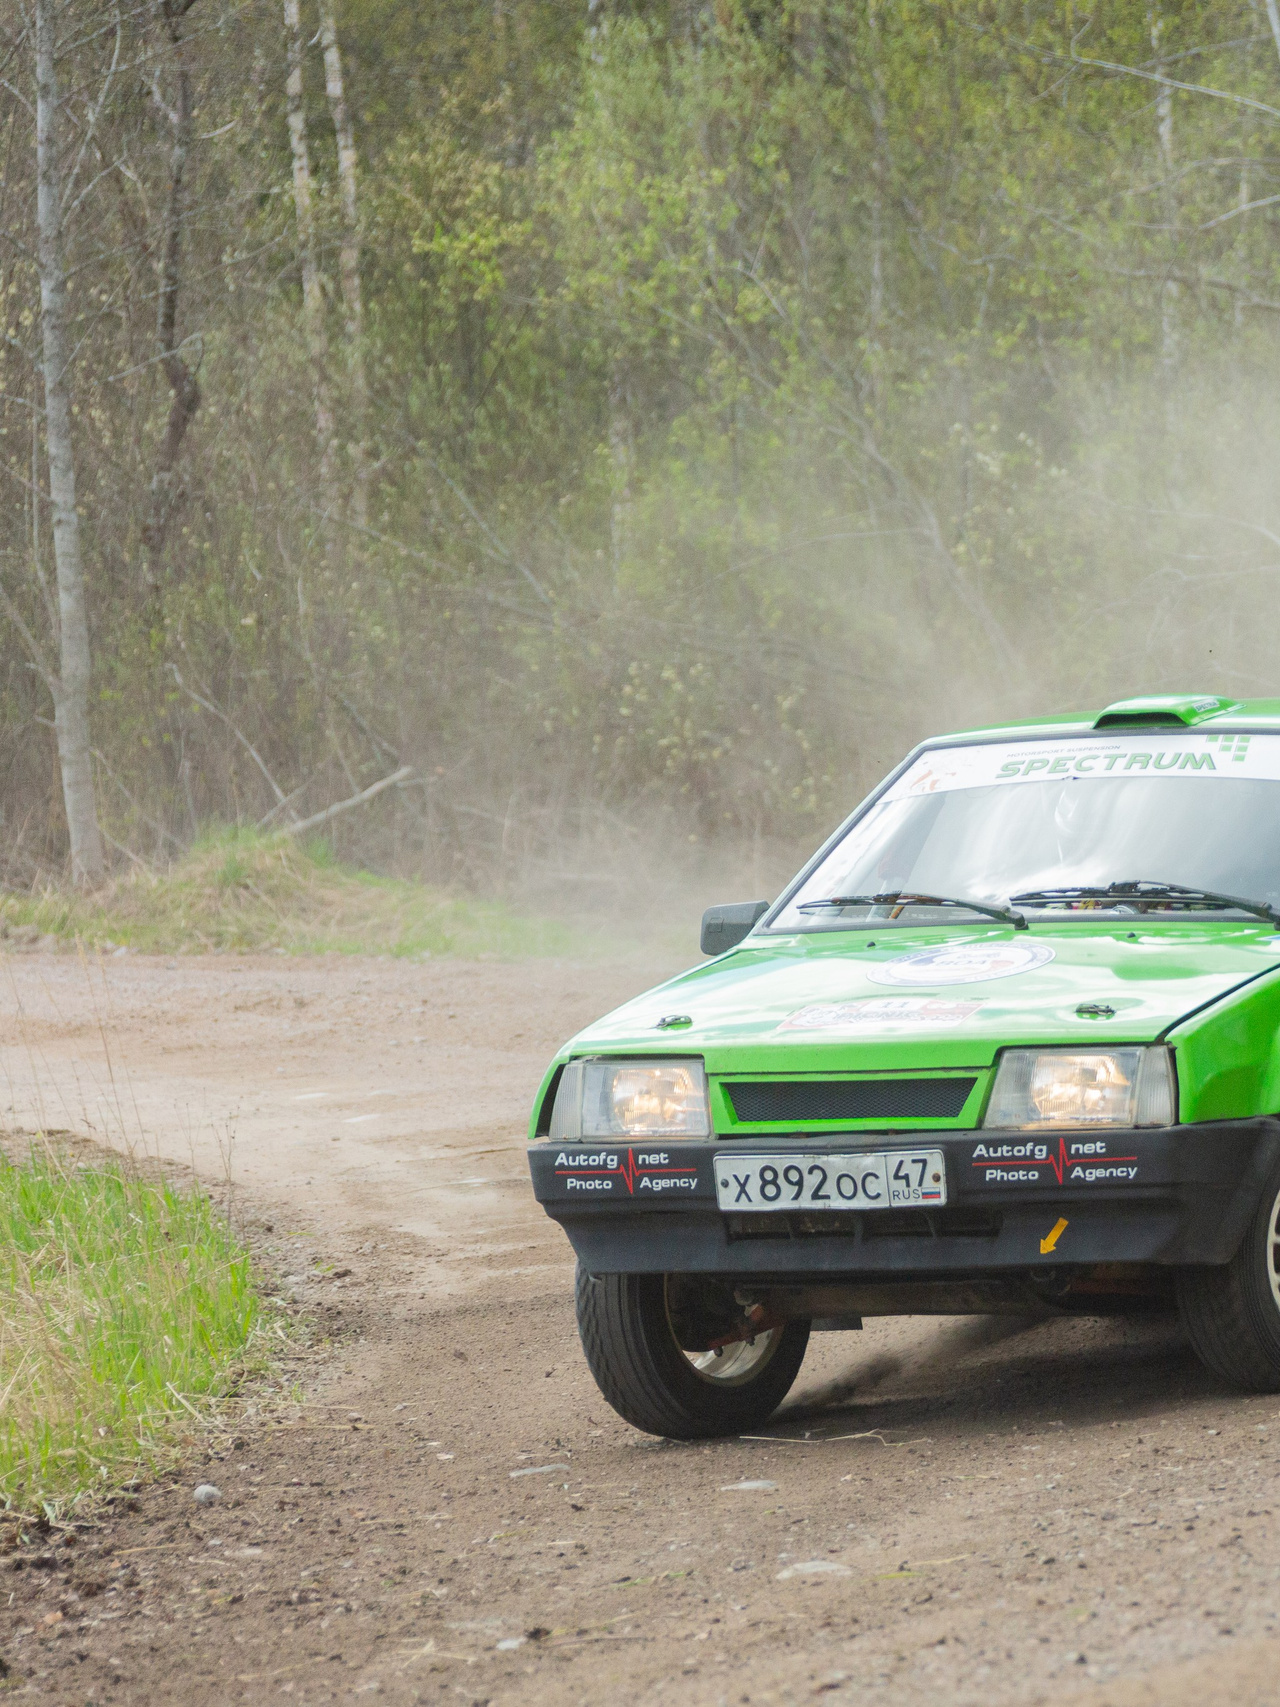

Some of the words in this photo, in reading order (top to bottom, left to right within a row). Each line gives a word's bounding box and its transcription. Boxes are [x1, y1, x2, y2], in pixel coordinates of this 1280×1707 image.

[1006, 748, 1065, 758] MOTORSPORT
[1067, 744, 1121, 754] SUSPENSION
[995, 752, 1217, 779] SPECTRUM
[972, 1142, 1047, 1159] Autofg
[1070, 1141, 1107, 1155] net
[555, 1152, 618, 1169] Autofg
[638, 1152, 669, 1165] net
[892, 1157, 928, 1188] 47
[985, 1169, 1039, 1182] Photo
[1070, 1166, 1138, 1182] Agency
[640, 1176, 698, 1191] Agency
[892, 1188, 921, 1201] RUS
